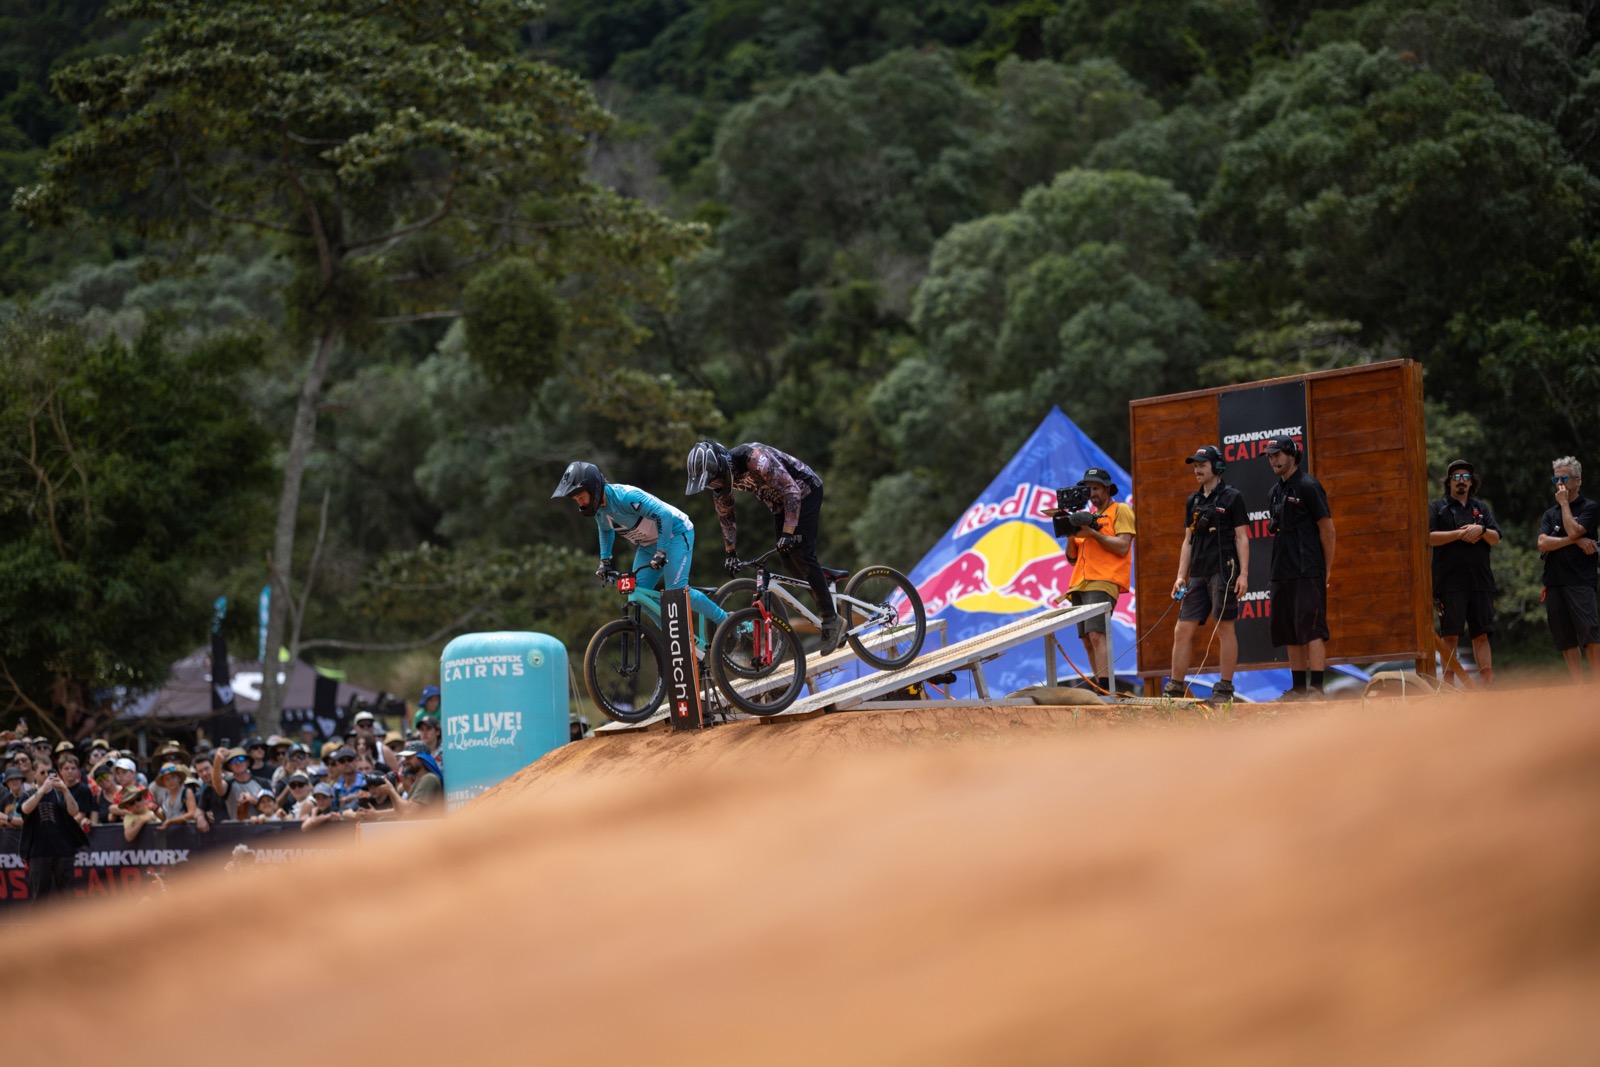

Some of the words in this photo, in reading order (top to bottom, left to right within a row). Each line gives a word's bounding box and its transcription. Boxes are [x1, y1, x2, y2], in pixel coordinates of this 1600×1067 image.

[1223, 425, 1303, 445] CRANKWORX
[952, 482, 1031, 540] Red
[621, 578, 631, 590] 25
[667, 602, 688, 700] swatch
[444, 663, 524, 682] CAIRNS
[447, 714, 470, 736] IT'S
[473, 711, 522, 733] LIVE!
[454, 727, 517, 751] Queensland
